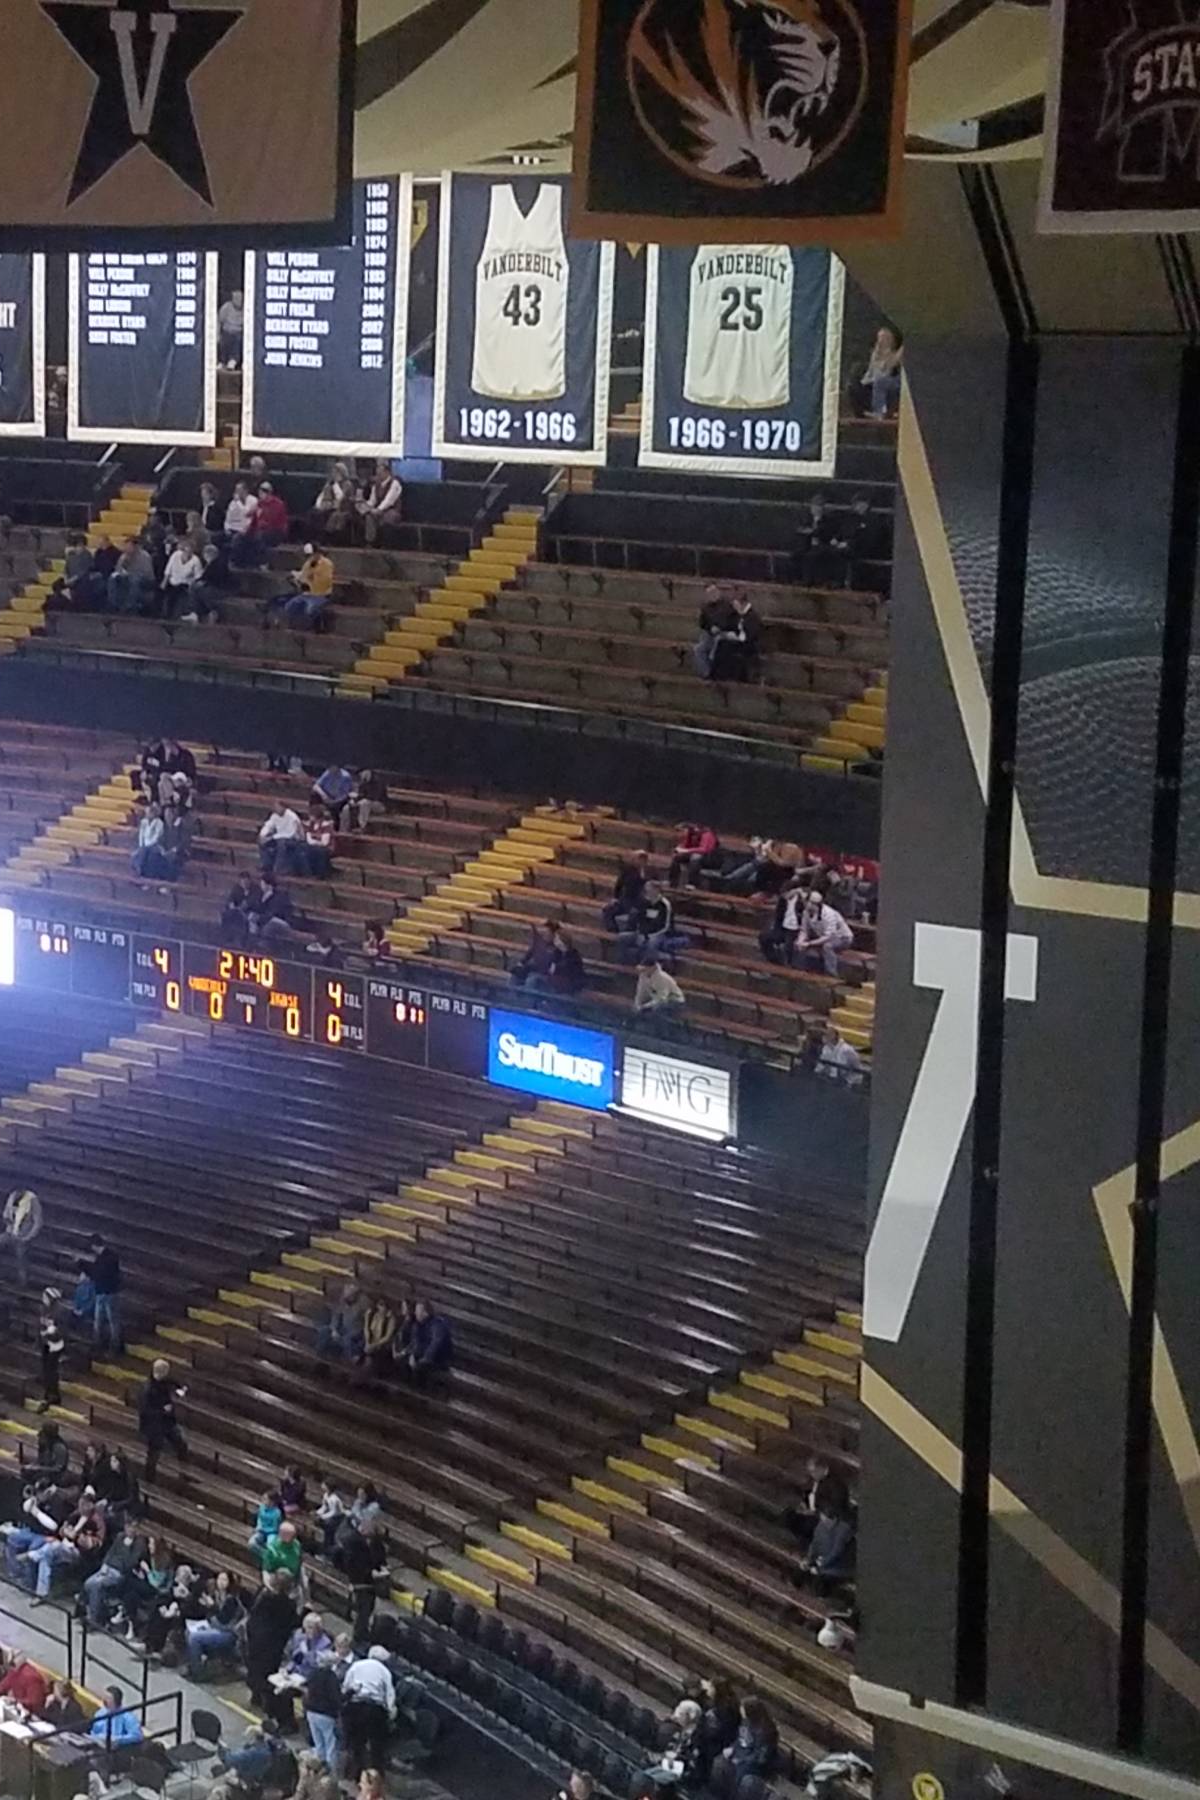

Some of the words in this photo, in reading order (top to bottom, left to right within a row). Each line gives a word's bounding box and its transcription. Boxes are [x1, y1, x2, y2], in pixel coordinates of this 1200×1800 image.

[109, 10, 177, 134] V
[1131, 41, 1200, 103] STA
[484, 253, 563, 281] VANDERBILT
[699, 253, 787, 284] VANDERBILT
[502, 284, 543, 327] 43
[719, 286, 764, 332] 25
[460, 408, 576, 442] 1962-1966
[668, 416, 801, 451] 1966-1970
[154, 948, 169, 974] 4
[219, 951, 275, 988] 21:40
[166, 981, 180, 1010] 0
[209, 991, 224, 1020] 0
[328, 981, 342, 1008] 4
[245, 1005, 253, 1024] 1
[286, 1008, 300, 1036] 0
[327, 1013, 341, 1042] 0
